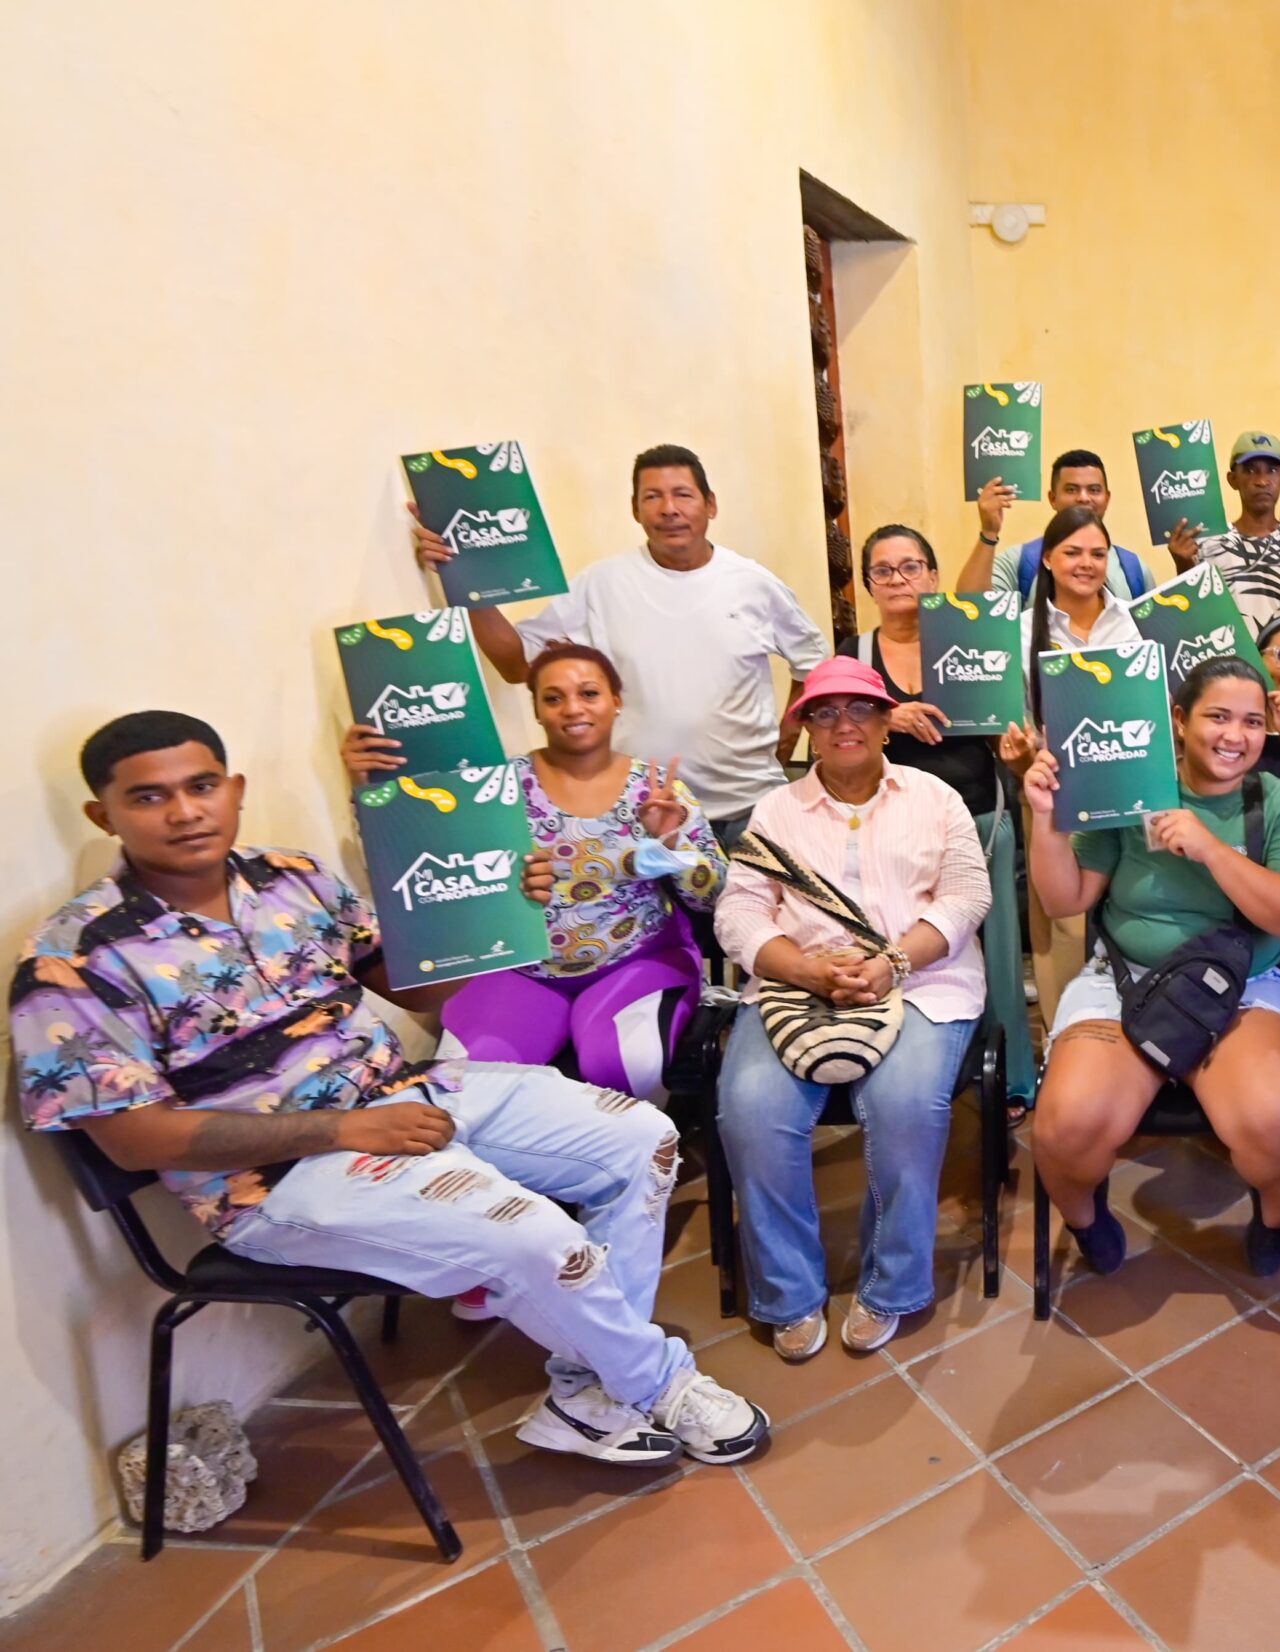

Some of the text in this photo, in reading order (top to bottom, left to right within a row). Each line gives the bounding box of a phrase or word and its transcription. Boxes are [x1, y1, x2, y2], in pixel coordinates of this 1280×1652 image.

[980, 441, 1009, 452] CASA
[1160, 483, 1188, 496] CASA
[457, 527, 504, 544] CASA
[1180, 650, 1192, 662] MI
[1182, 648, 1217, 670] CASA
[946, 664, 983, 676] CASA
[958, 674, 1003, 682] PROPIEDAD
[384, 704, 436, 723] CASA
[403, 710, 466, 728] PROPIEDAD
[1078, 732, 1092, 743] MI
[1077, 740, 1122, 757] CASA
[1092, 750, 1148, 762] PROPIEDAD
[414, 868, 434, 883] MI
[414, 875, 476, 897] CASA
[436, 882, 508, 902] PROPIEDAD
